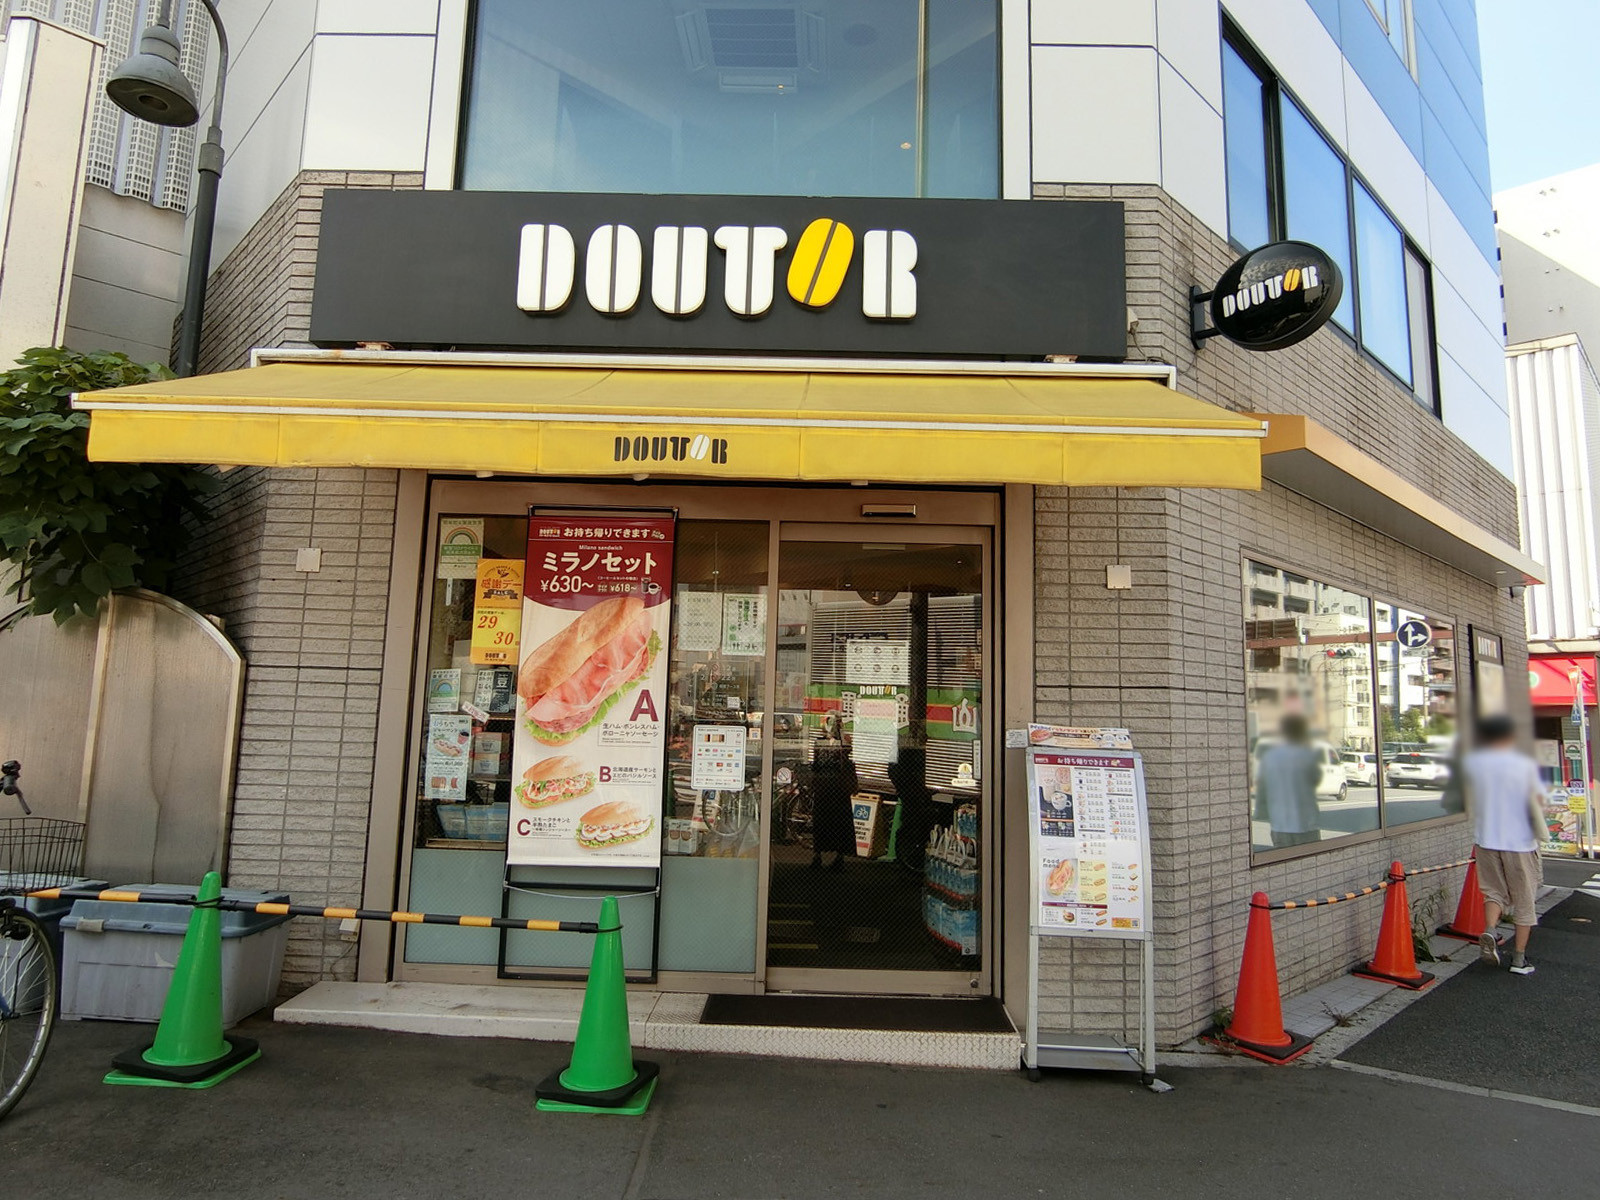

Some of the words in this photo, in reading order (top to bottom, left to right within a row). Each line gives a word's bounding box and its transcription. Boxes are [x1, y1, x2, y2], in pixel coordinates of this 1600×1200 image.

[516, 217, 918, 319] DOUTOR
[1222, 266, 1319, 318] DOUTOR
[614, 434, 728, 464] DOUTOR
[563, 527, 651, 539] お持ち帰りできます
[542, 551, 658, 575] ミラノセット
[477, 615, 498, 629] 29
[493, 631, 514, 646] 30
[859, 685, 897, 696] DOUTOR
[629, 689, 659, 722] A
[599, 765, 612, 783] B
[516, 818, 531, 836] C
